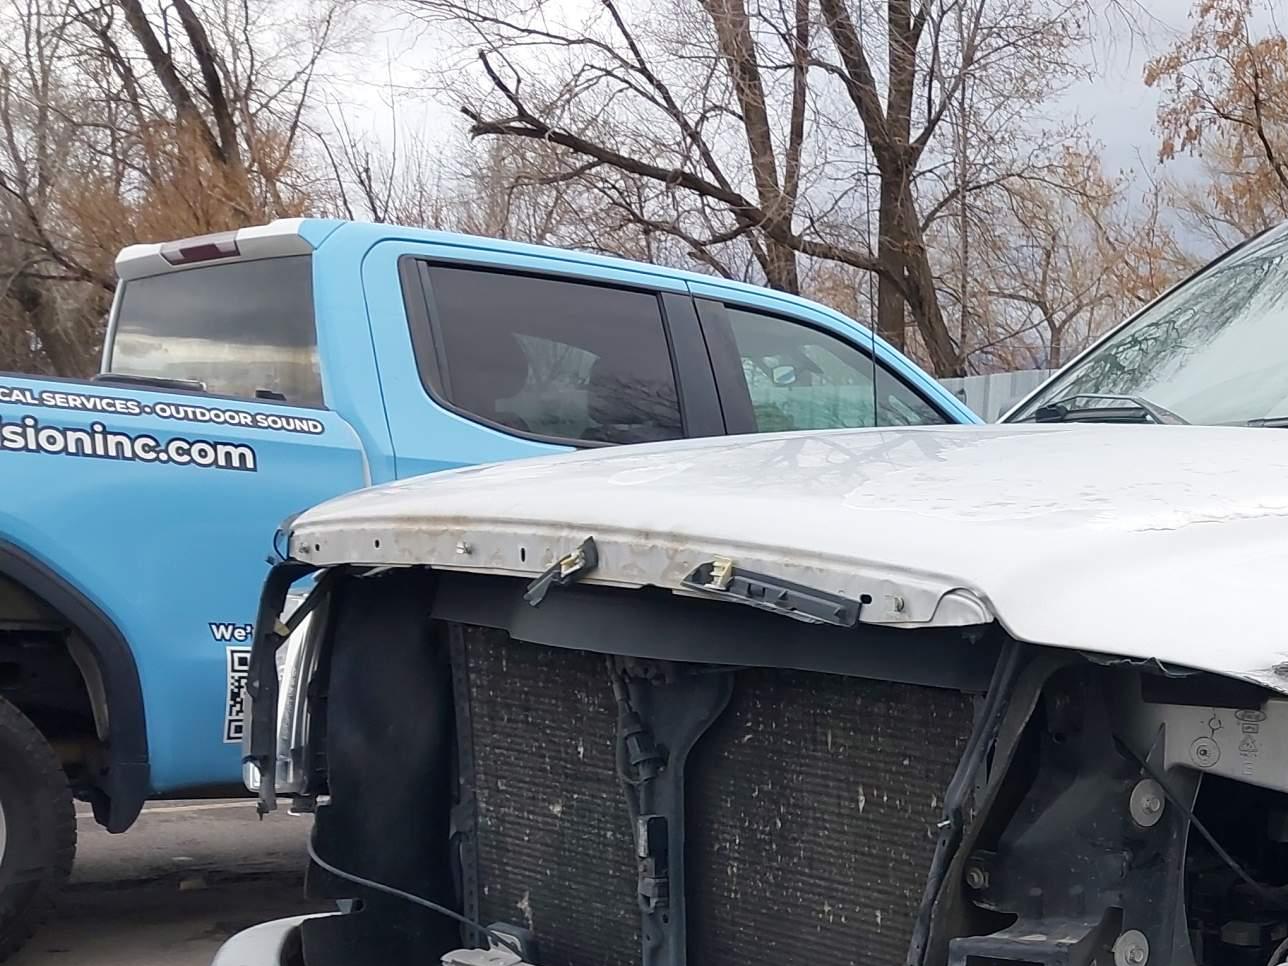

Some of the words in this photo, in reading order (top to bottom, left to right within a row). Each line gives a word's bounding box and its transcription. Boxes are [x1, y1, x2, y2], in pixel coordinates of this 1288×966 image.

[41, 391, 140, 414] SERVICES
[155, 403, 253, 426] OUTDOOR
[256, 414, 323, 434] SOUND
[211, 624, 254, 641] We'
